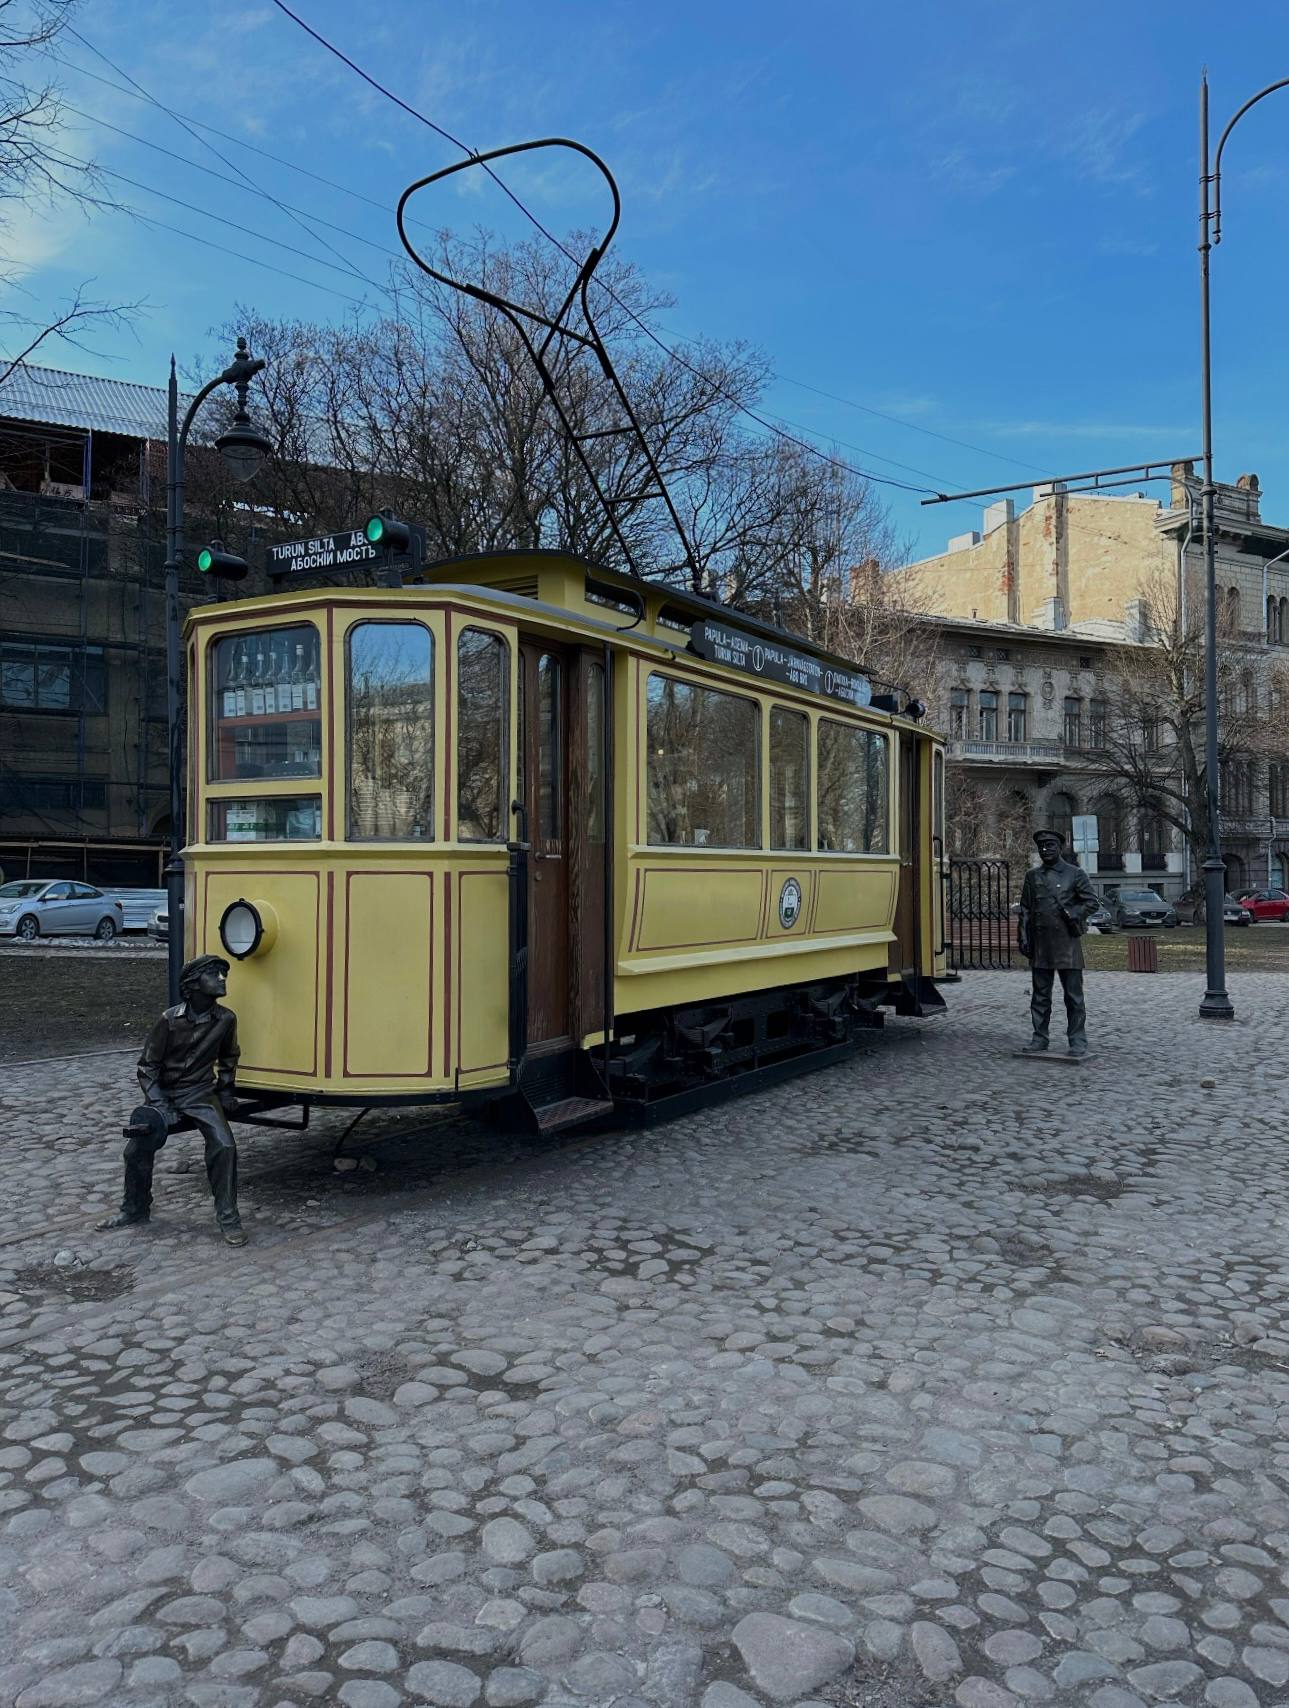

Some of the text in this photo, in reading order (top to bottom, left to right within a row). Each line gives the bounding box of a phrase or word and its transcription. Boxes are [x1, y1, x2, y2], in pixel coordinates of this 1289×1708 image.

[272, 543, 304, 560] TURUN
[308, 537, 335, 554] SILTA
[336, 545, 376, 564] МОСТЪ
